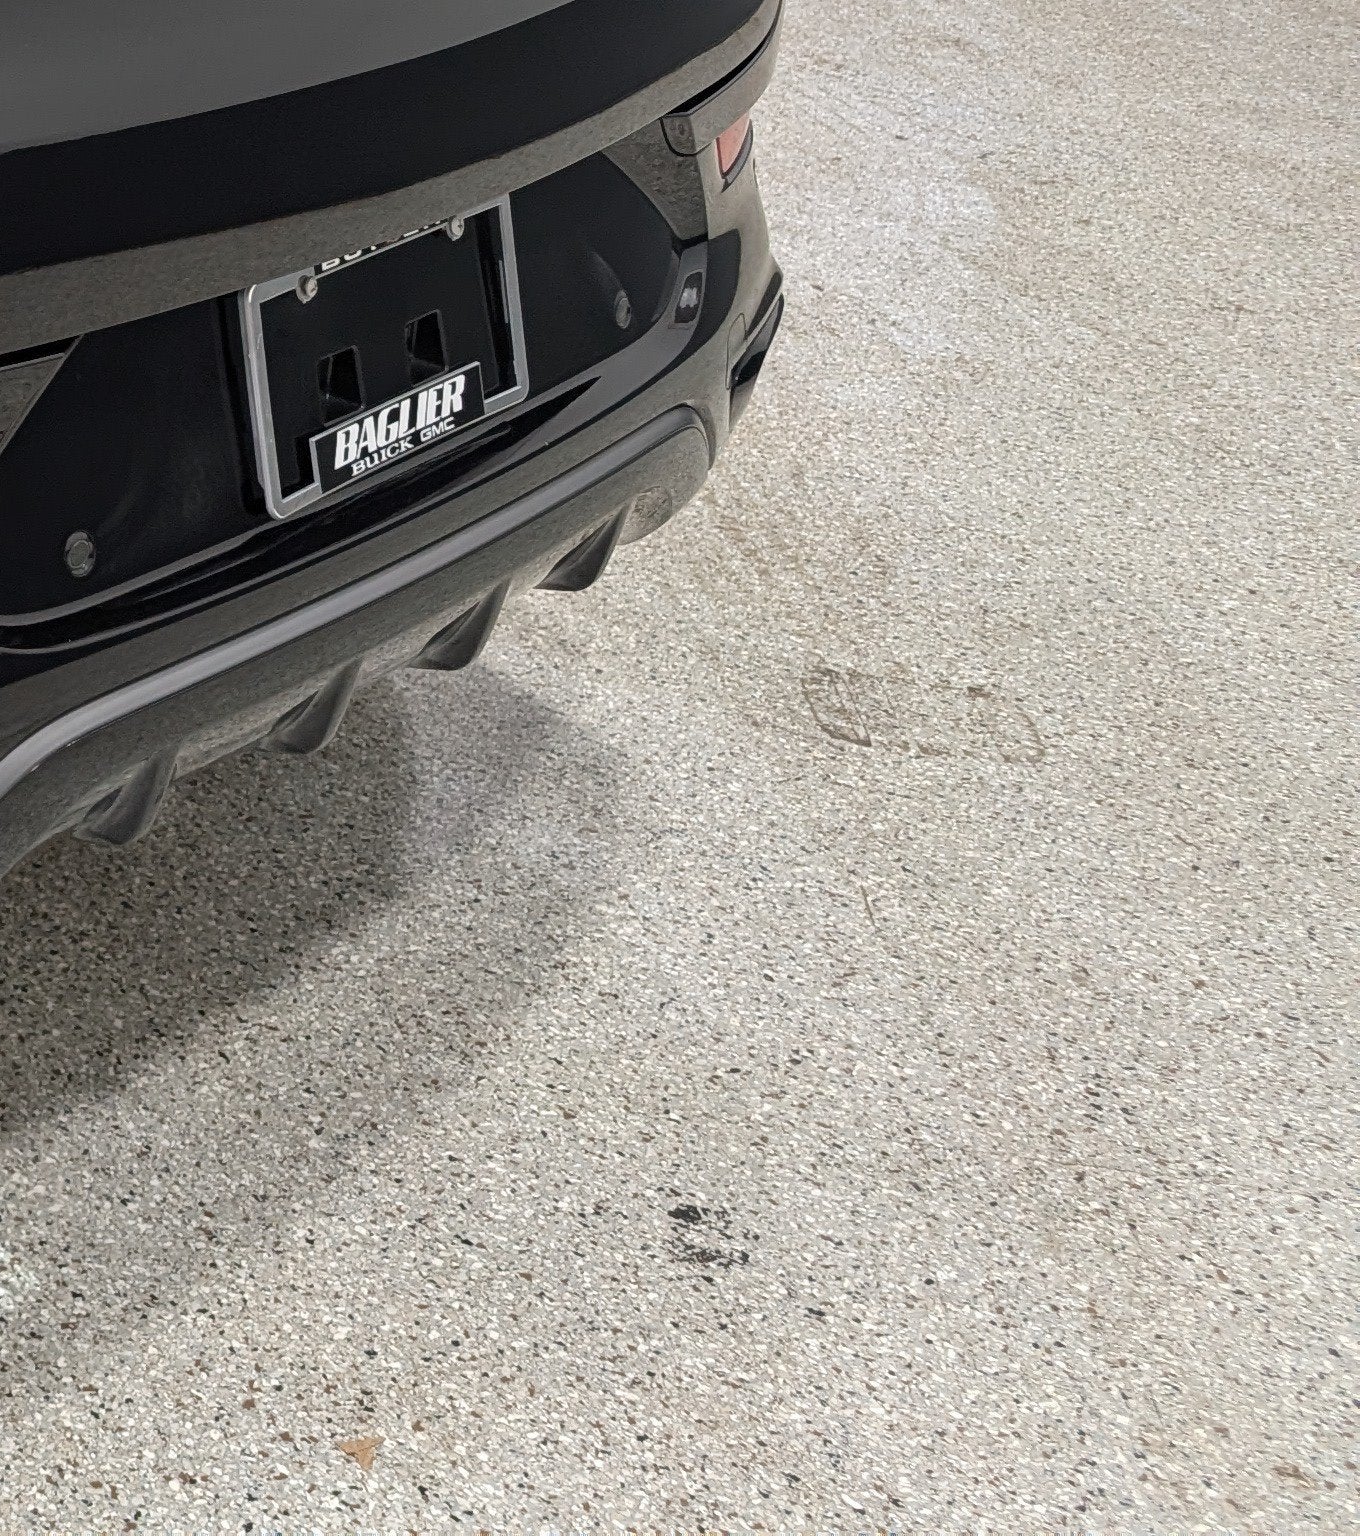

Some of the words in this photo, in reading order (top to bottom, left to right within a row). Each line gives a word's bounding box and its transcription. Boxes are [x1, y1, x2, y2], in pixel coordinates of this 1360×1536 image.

[333, 373, 466, 471] BAGLIER
[350, 435, 415, 477] BUICK
[419, 416, 456, 442] GMC
